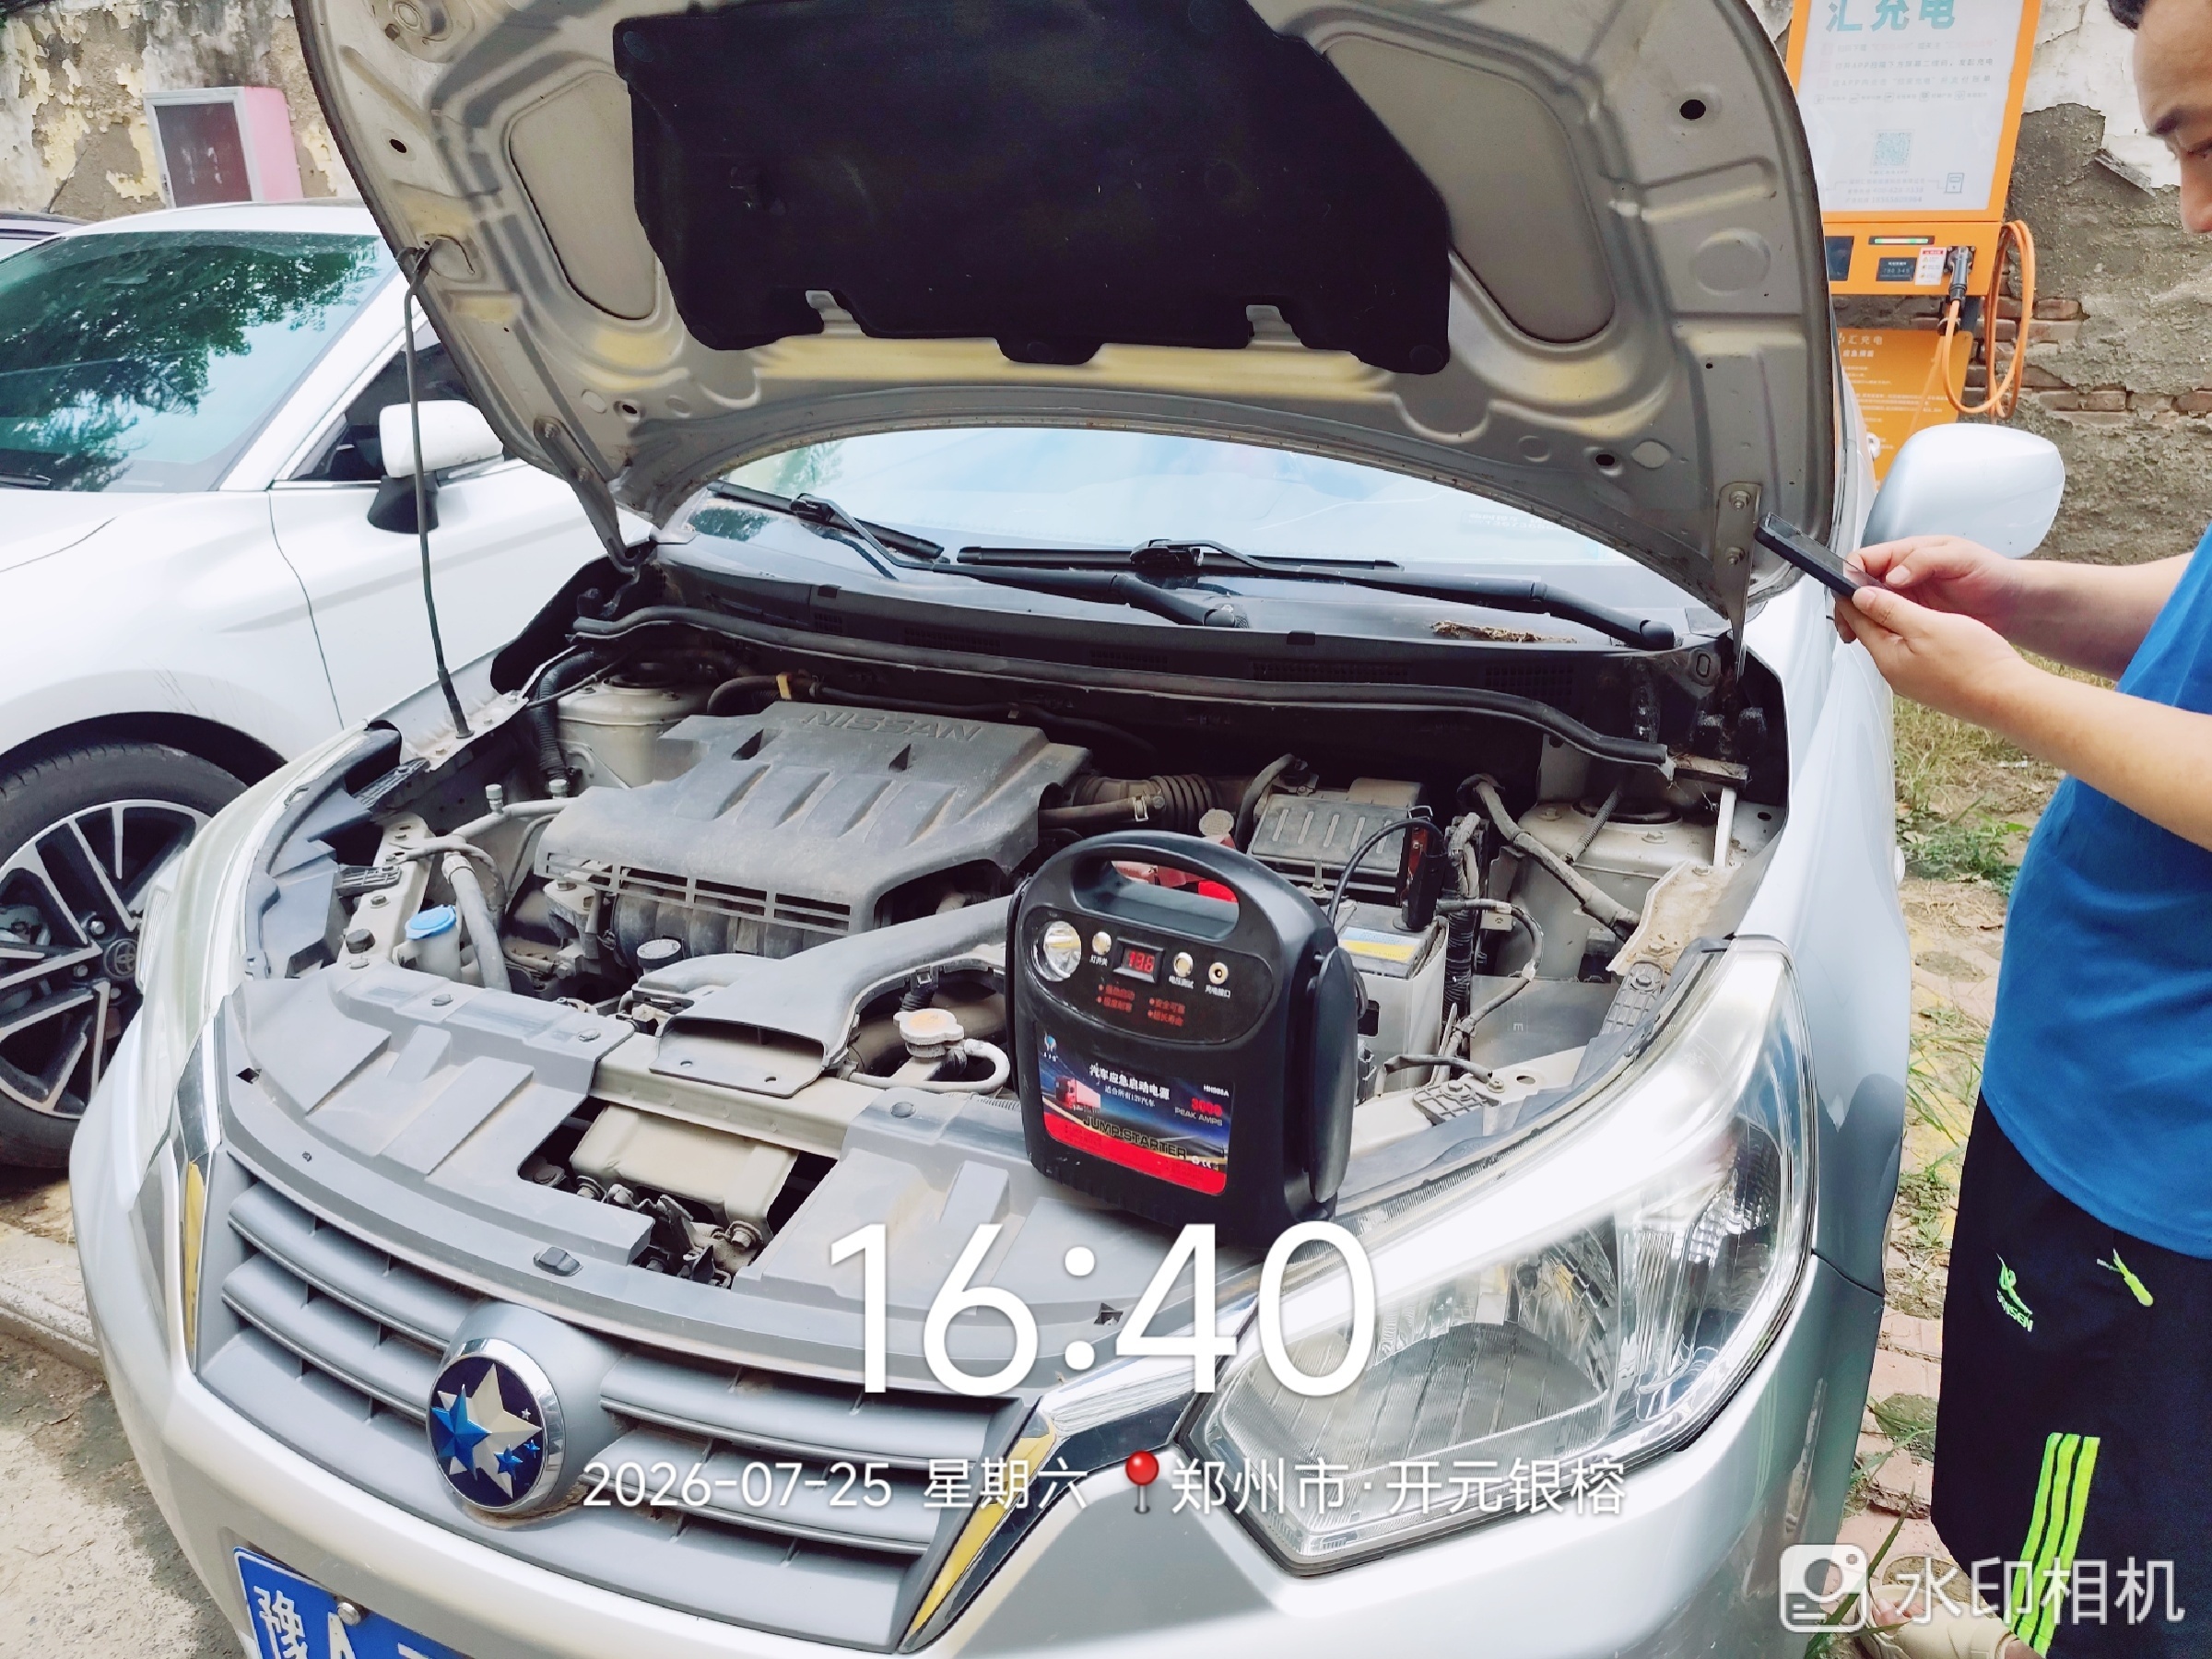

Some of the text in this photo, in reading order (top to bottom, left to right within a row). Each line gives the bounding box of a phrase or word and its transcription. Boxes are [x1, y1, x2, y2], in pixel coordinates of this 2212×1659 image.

[1826, 0, 1955, 32] 汇充电
[801, 710, 982, 742] NISSAN
[1088, 1062, 1171, 1100] 汽车应急启动电源
[1174, 1106, 1223, 1126] PEAK AMPS
